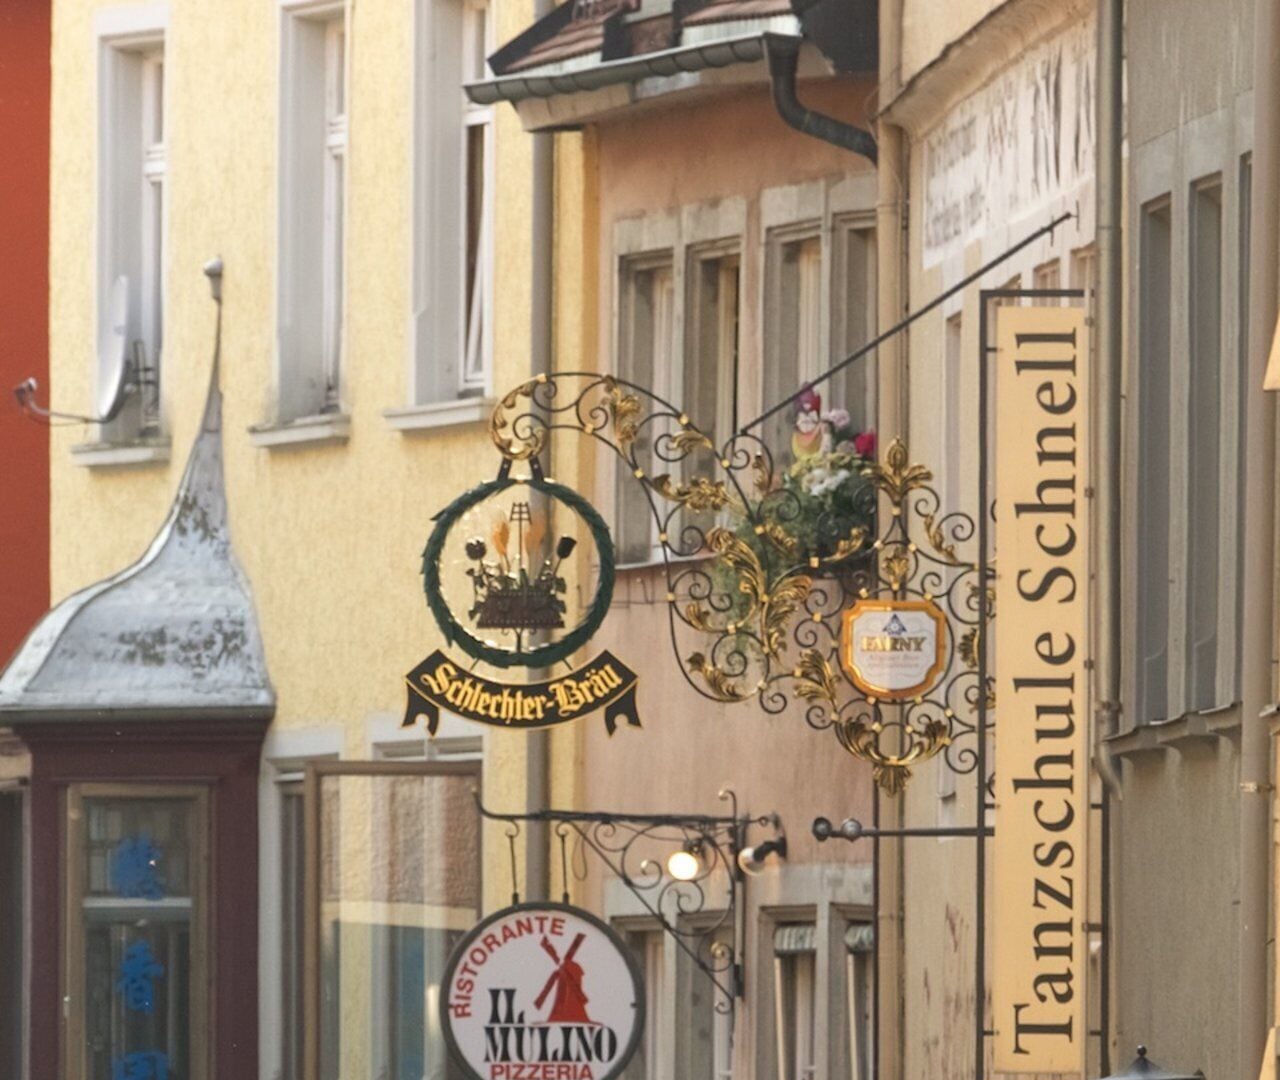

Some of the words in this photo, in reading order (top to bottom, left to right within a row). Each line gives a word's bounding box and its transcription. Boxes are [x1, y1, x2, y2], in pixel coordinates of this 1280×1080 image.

[1014, 326, 1078, 605] Schnell
[420, 663, 623, 725] Schlechter-Bräu
[1012, 630, 1077, 1056] Tanzschule
[453, 916, 567, 1019] RISTORANTE
[488, 987, 525, 1024] IL
[483, 1026, 618, 1063] MULINO
[489, 1064, 595, 1080] PIZZERIA
